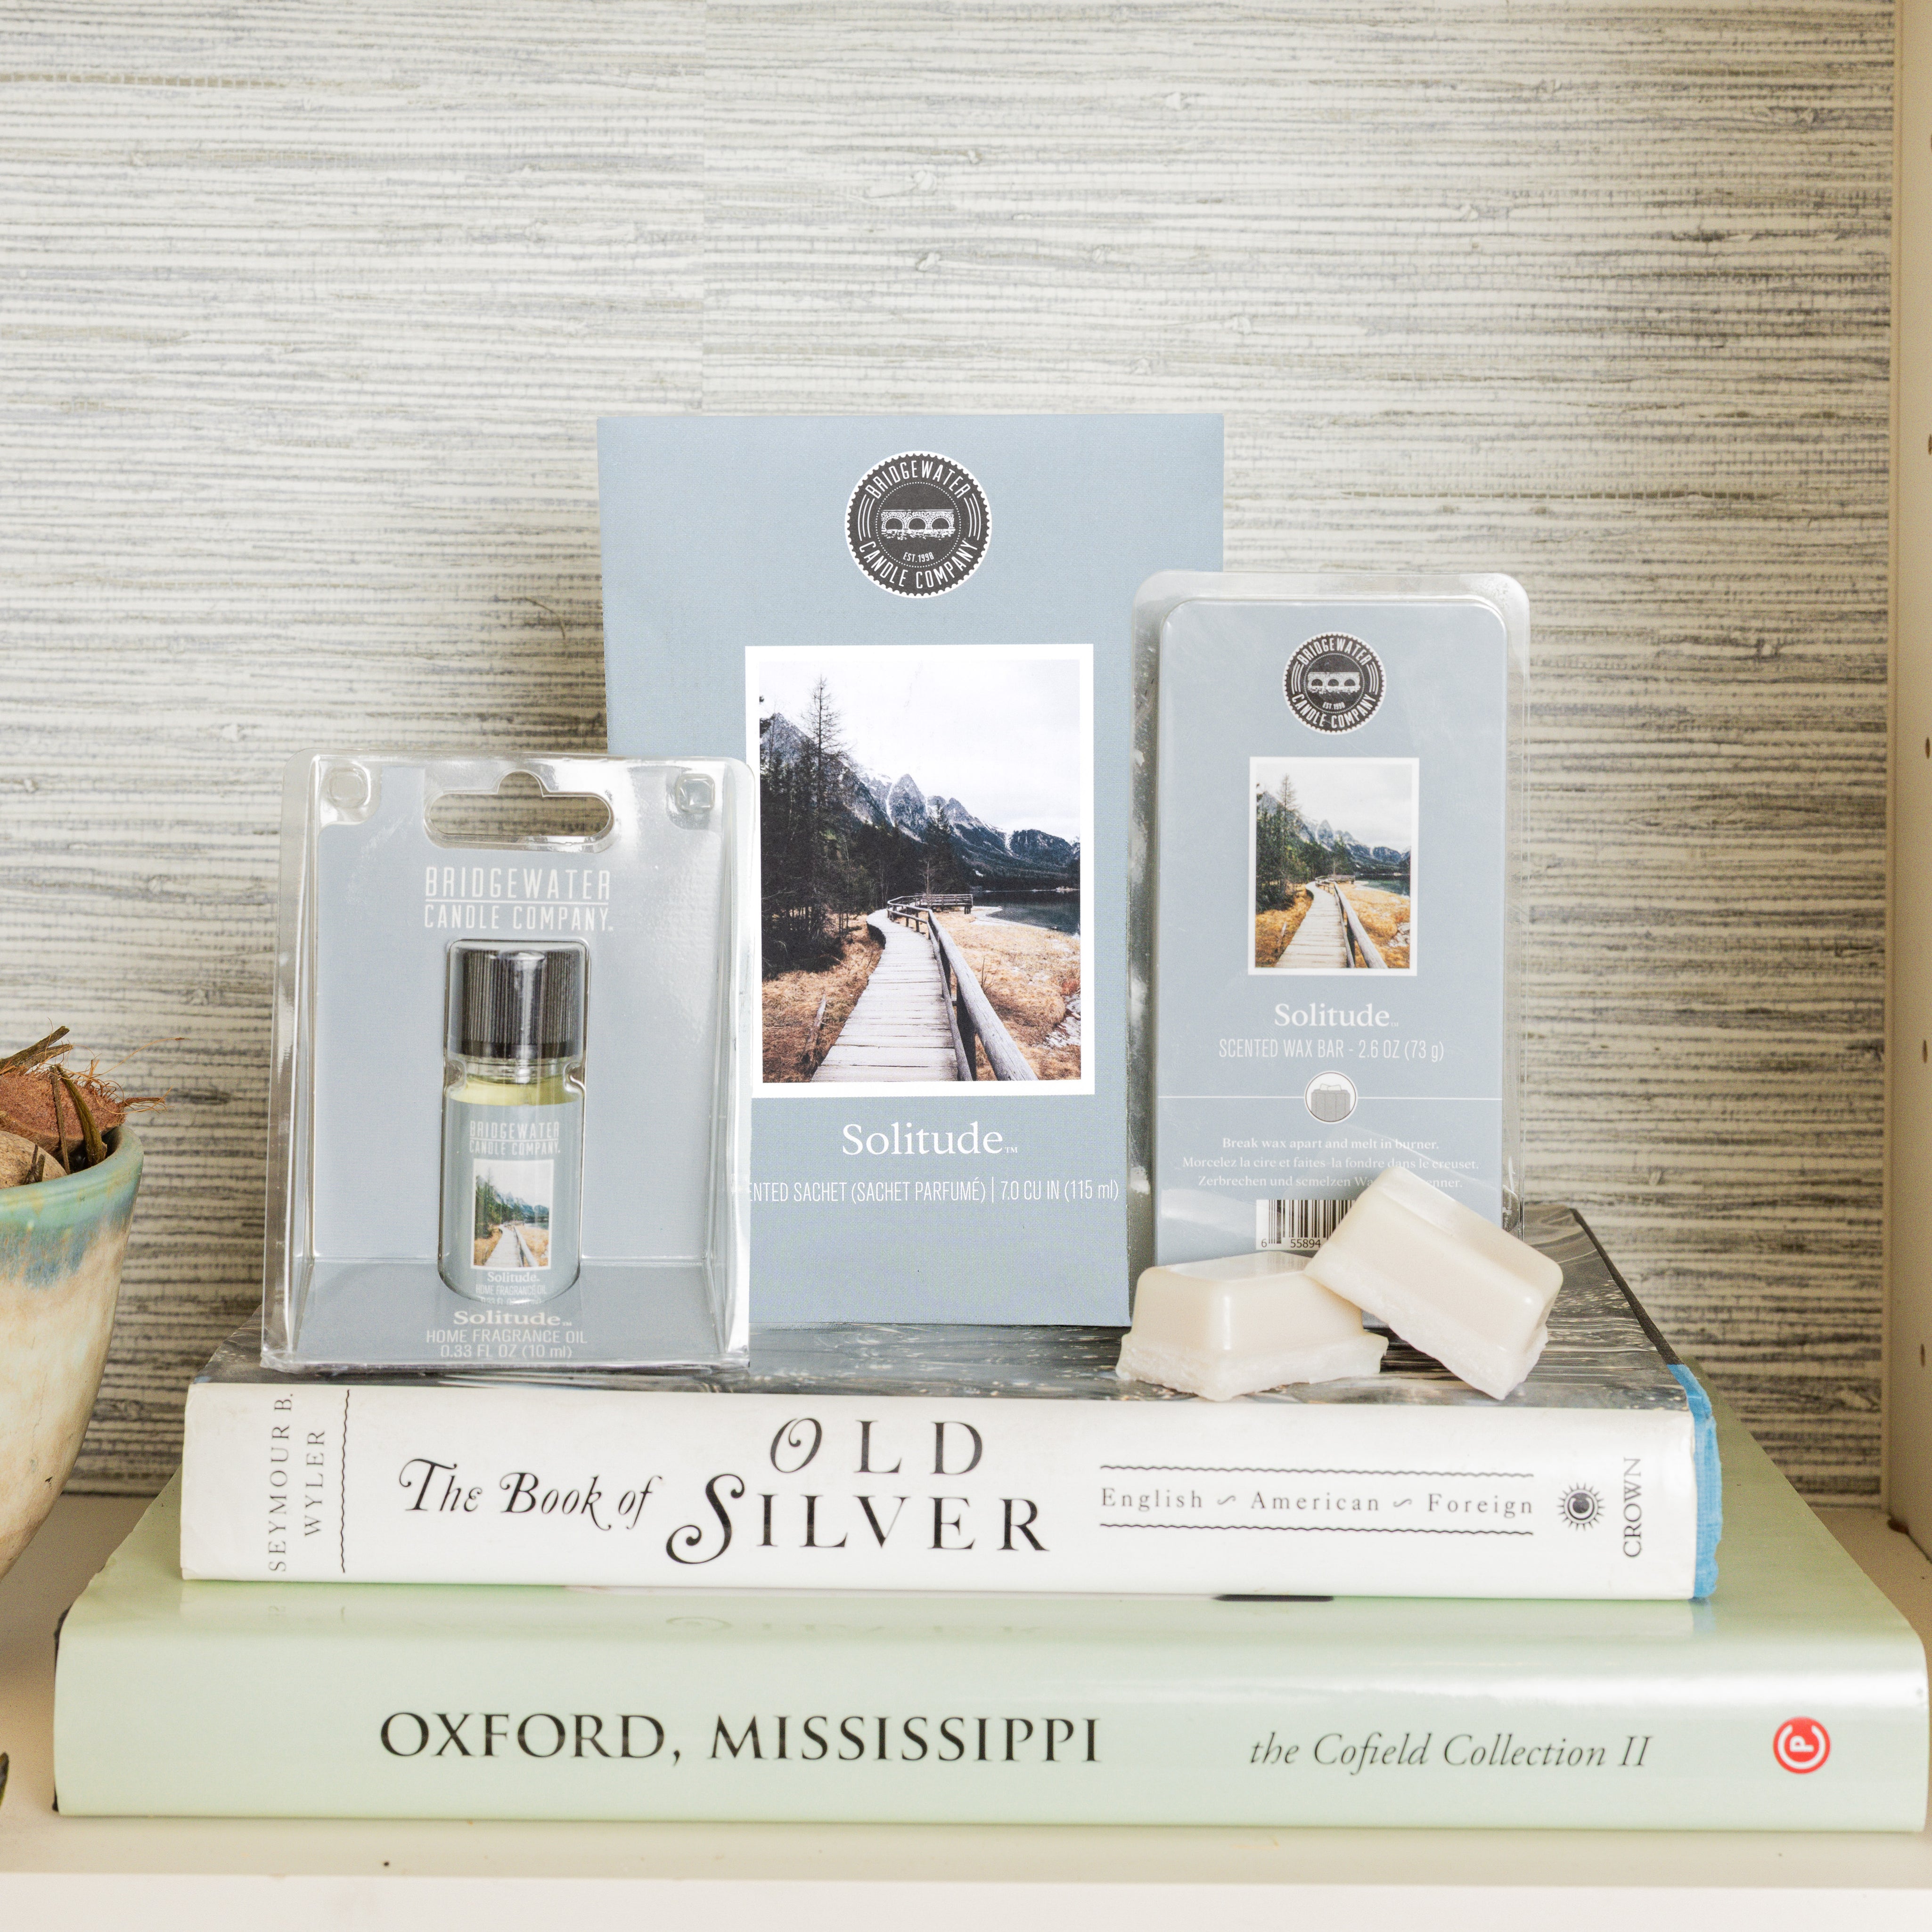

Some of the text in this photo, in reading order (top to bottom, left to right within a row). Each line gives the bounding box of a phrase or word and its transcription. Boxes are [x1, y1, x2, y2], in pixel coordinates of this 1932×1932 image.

[865, 460, 971, 499] BRIDGEWATER
[859, 540, 978, 589] CANDLE COMPANY
[903, 551, 934, 563] EST. 1998
[1296, 638, 1372, 665] BRIDGEWATER
[1292, 694, 1376, 729] CANDLE COMPANY
[425, 867, 610, 901] BRIDGEWATER
[425, 904, 499, 929] CANDLE
[1219, 1039, 1278, 1058] SCENTED
[1283, 1039, 1313, 1058] WAX
[1318, 1039, 1344, 1058] BAR
[1358, 1040, 1378, 1059] 2.6
[1383, 1040, 1400, 1059] OZ
[1404, 1040, 1427, 1062] (73
[1431, 1040, 1444, 1063] g)
[470, 1120, 559, 1139] BRIDGEWATER
[469, 1139, 506, 1155] CANDLE
[1223, 1138, 1439, 1150] Break wax apart and melt in burner.
[1182, 1157, 1237, 1168] Morcelez
[1240, 1157, 1251, 1168] la
[1253, 1157, 1277, 1168] cire
[1279, 1158, 1290, 1168] et
[1345, 1157, 1384, 1168] fondre
[1387, 1158, 1416, 1169] dans
[1419, 1158, 1430, 1169] le
[1432, 1159, 1480, 1170] creuset.
[750, 1182, 788, 1202] NTED
[794, 1182, 848, 1202] SACHET
[851, 1181, 910, 1205] (SACHET
[915, 1177, 986, 1204] PARFUMÉ)
[1001, 1181, 1019, 1201] 7.0
[1023, 1180, 1042, 1201] CU
[1047, 1180, 1060, 1201] IN
[1064, 1180, 1093, 1203] (115
[1098, 1179, 1119, 1202] ml)
[1198, 1175, 1267, 1187] Zerbrechen
[1270, 1176, 1293, 1187] und
[1295, 1176, 1351, 1187] scmelzen
[1428, 1179, 1463, 1188] enner.
[1261, 1238, 1321, 1249] 6 55894
[475, 1283, 547, 1295] HOME FRAGRANCE OIL
[426, 1328, 588, 1344] HOME FRAGRANCE OIL
[441, 1344, 573, 1359] 0.33 FL OZ (10 ml)
[770, 1417, 983, 1475] OLD
[268, 1392, 294, 1572] SEYMOUR B.
[304, 1430, 326, 1537] WYLER
[398, 1458, 663, 1531] The Book of
[1100, 1487, 1533, 1516] English American Foreign
[1623, 1457, 1642, 1557] CROWN
[665, 1473, 1051, 1565] SILVER
[380, 1711, 1101, 1767] OXFORD, MISSISSIPPI
[1249, 1731, 1654, 1776] the Cofield Collection II
